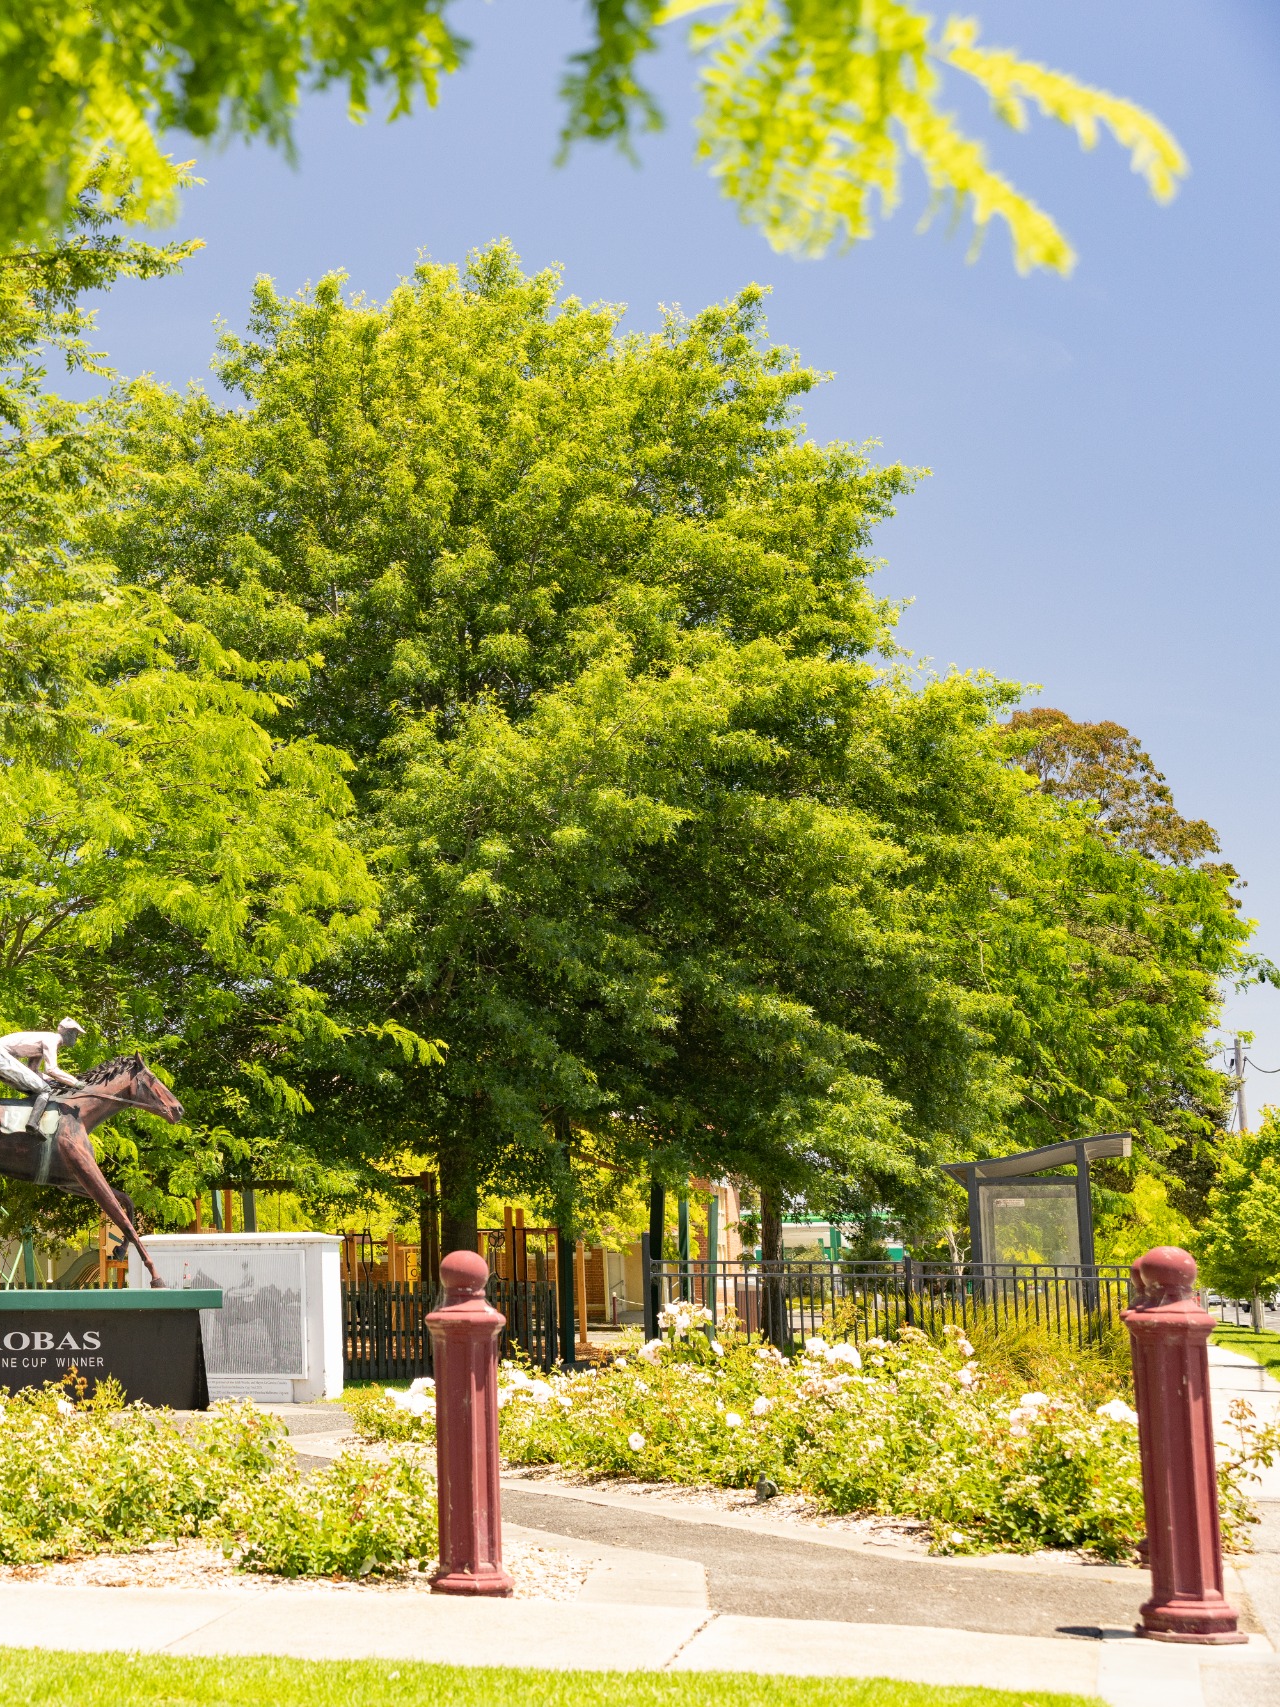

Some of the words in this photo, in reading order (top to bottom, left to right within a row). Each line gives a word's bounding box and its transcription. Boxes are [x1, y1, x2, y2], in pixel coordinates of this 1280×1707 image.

[4, 1110, 21, 1127] 19
[22, 1357, 47, 1368] CUP
[56, 1356, 104, 1368] WINNER
